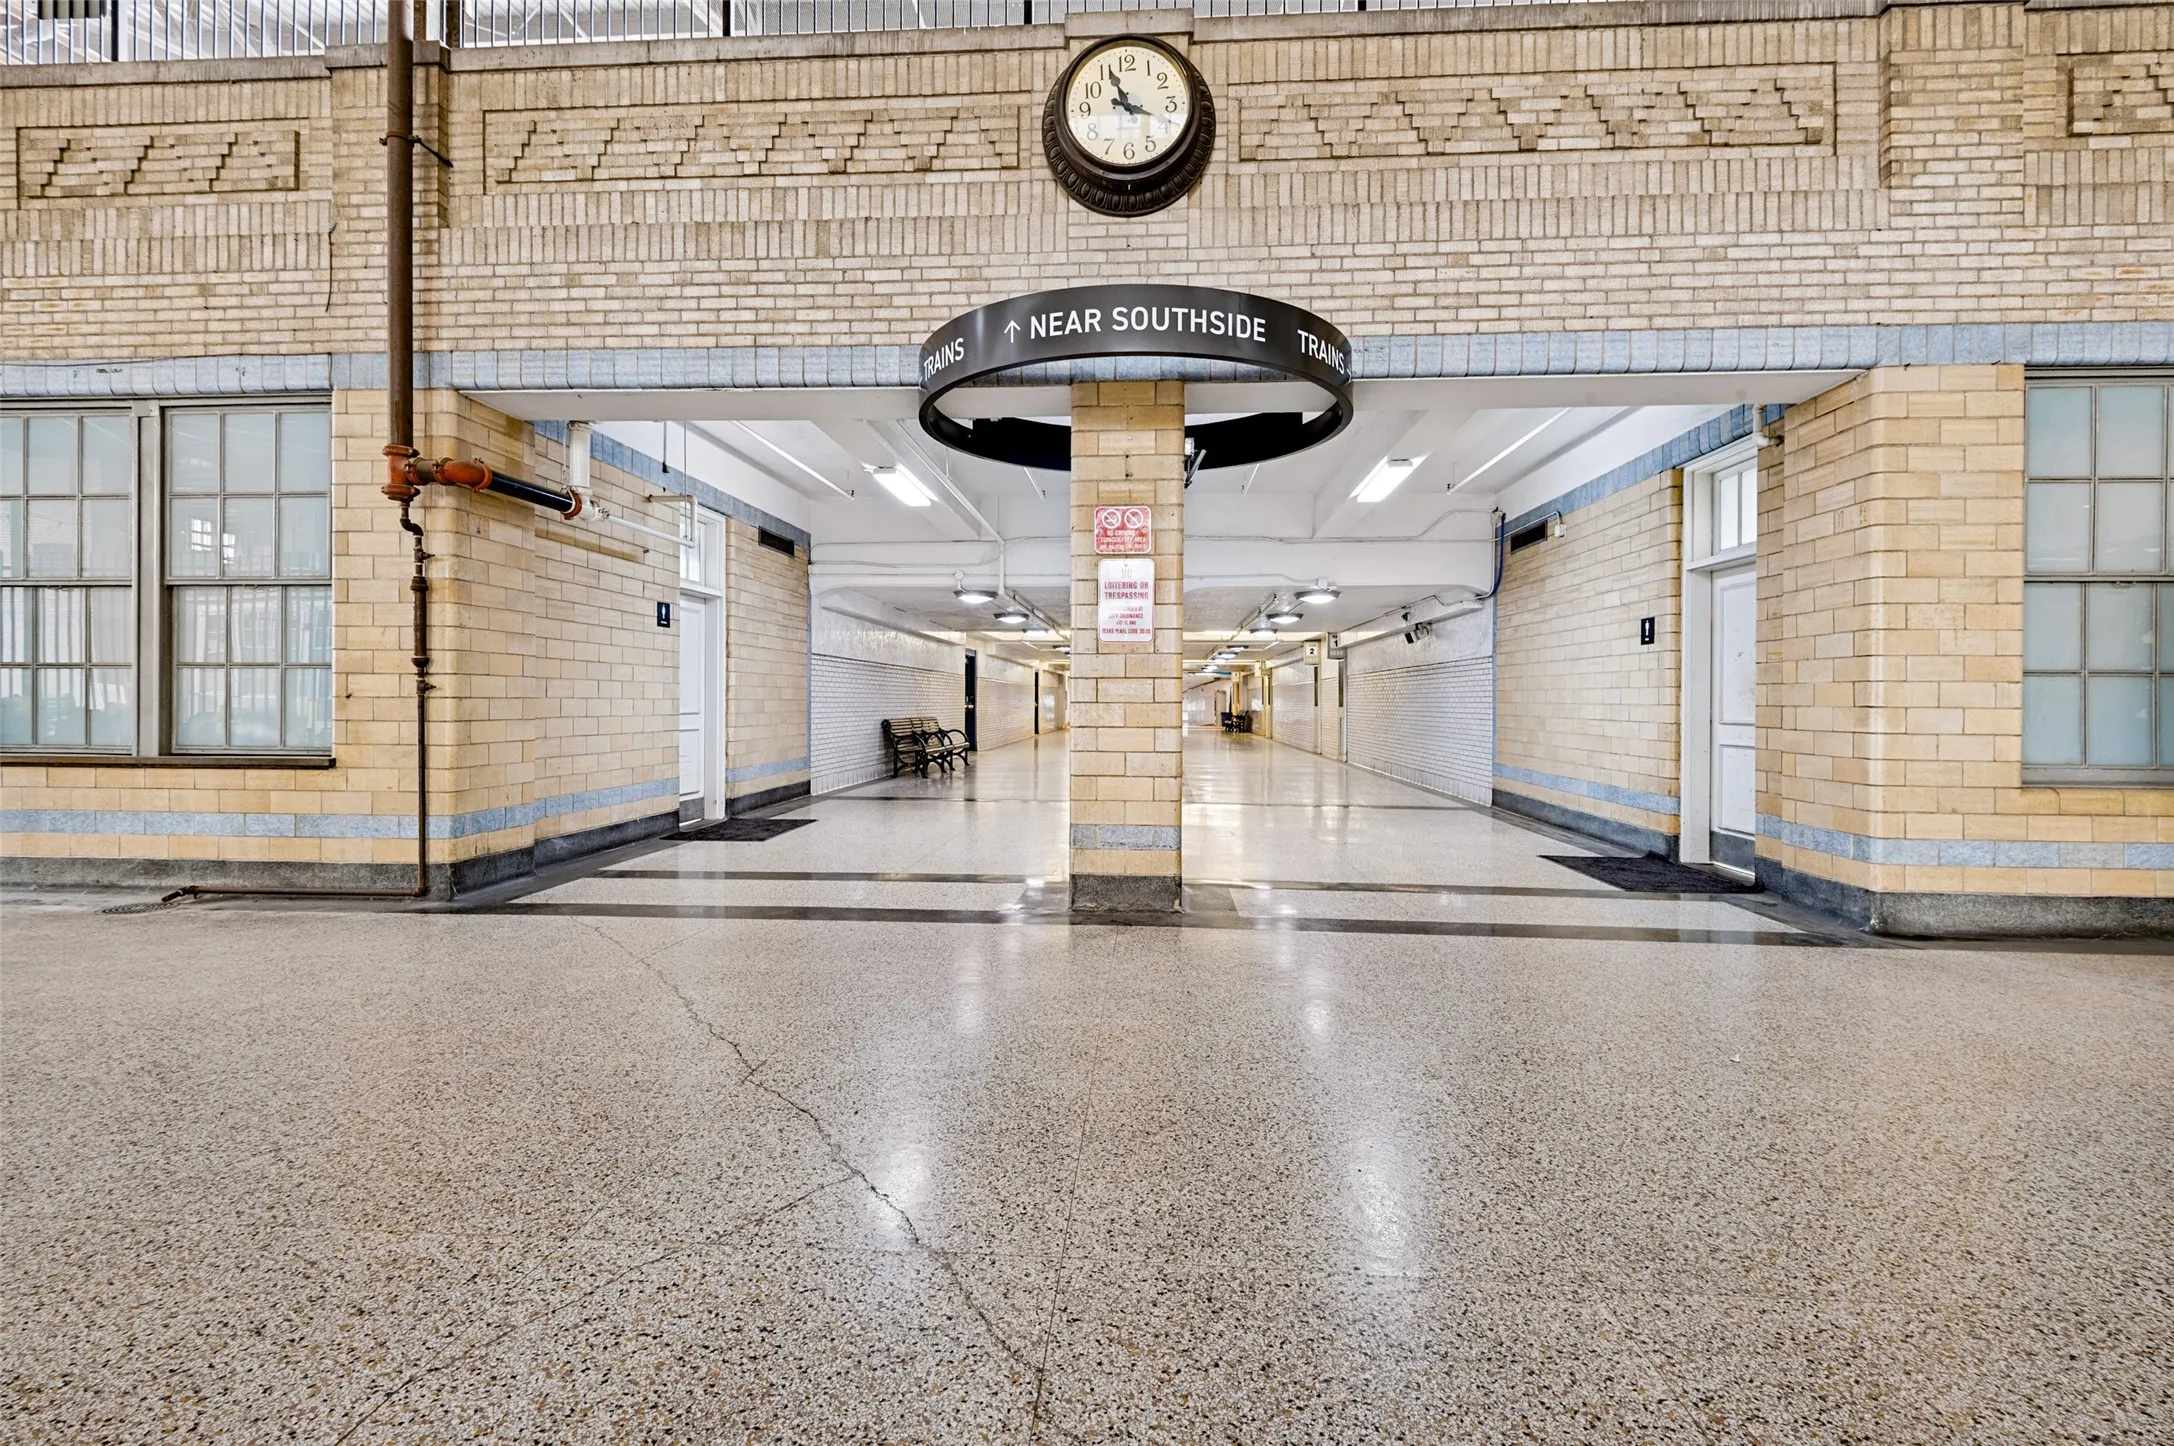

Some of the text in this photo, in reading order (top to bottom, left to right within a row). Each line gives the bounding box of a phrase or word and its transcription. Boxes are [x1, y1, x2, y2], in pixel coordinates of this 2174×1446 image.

[1118, 54, 1137, 72] 12
[1147, 60, 1151, 76] 1
[1100, 64, 1113, 80] 11
[1157, 72, 1169, 90] 2
[1085, 81, 1102, 99] 10
[1079, 101, 1092, 119] 9
[1165, 95, 1178, 113] 3
[1087, 123, 1098, 140] 8
[1157, 119, 1169, 135] 4
[1104, 138, 1115, 155] 7
[1123, 142, 1135, 160] 6
[1145, 135, 1156, 152] 5
[1030, 306, 1266, 342] NEAR SOUTHSIDE
[923, 337, 965, 382] TRAINS
[1297, 329, 1345, 375] TRAINS
[1121, 568, 1133, 579] NO
[1104, 581, 1149, 590] LOITERING OR
[1104, 592, 1149, 600] TRESPASSING
[1334, 639, 1338, 647] 1
